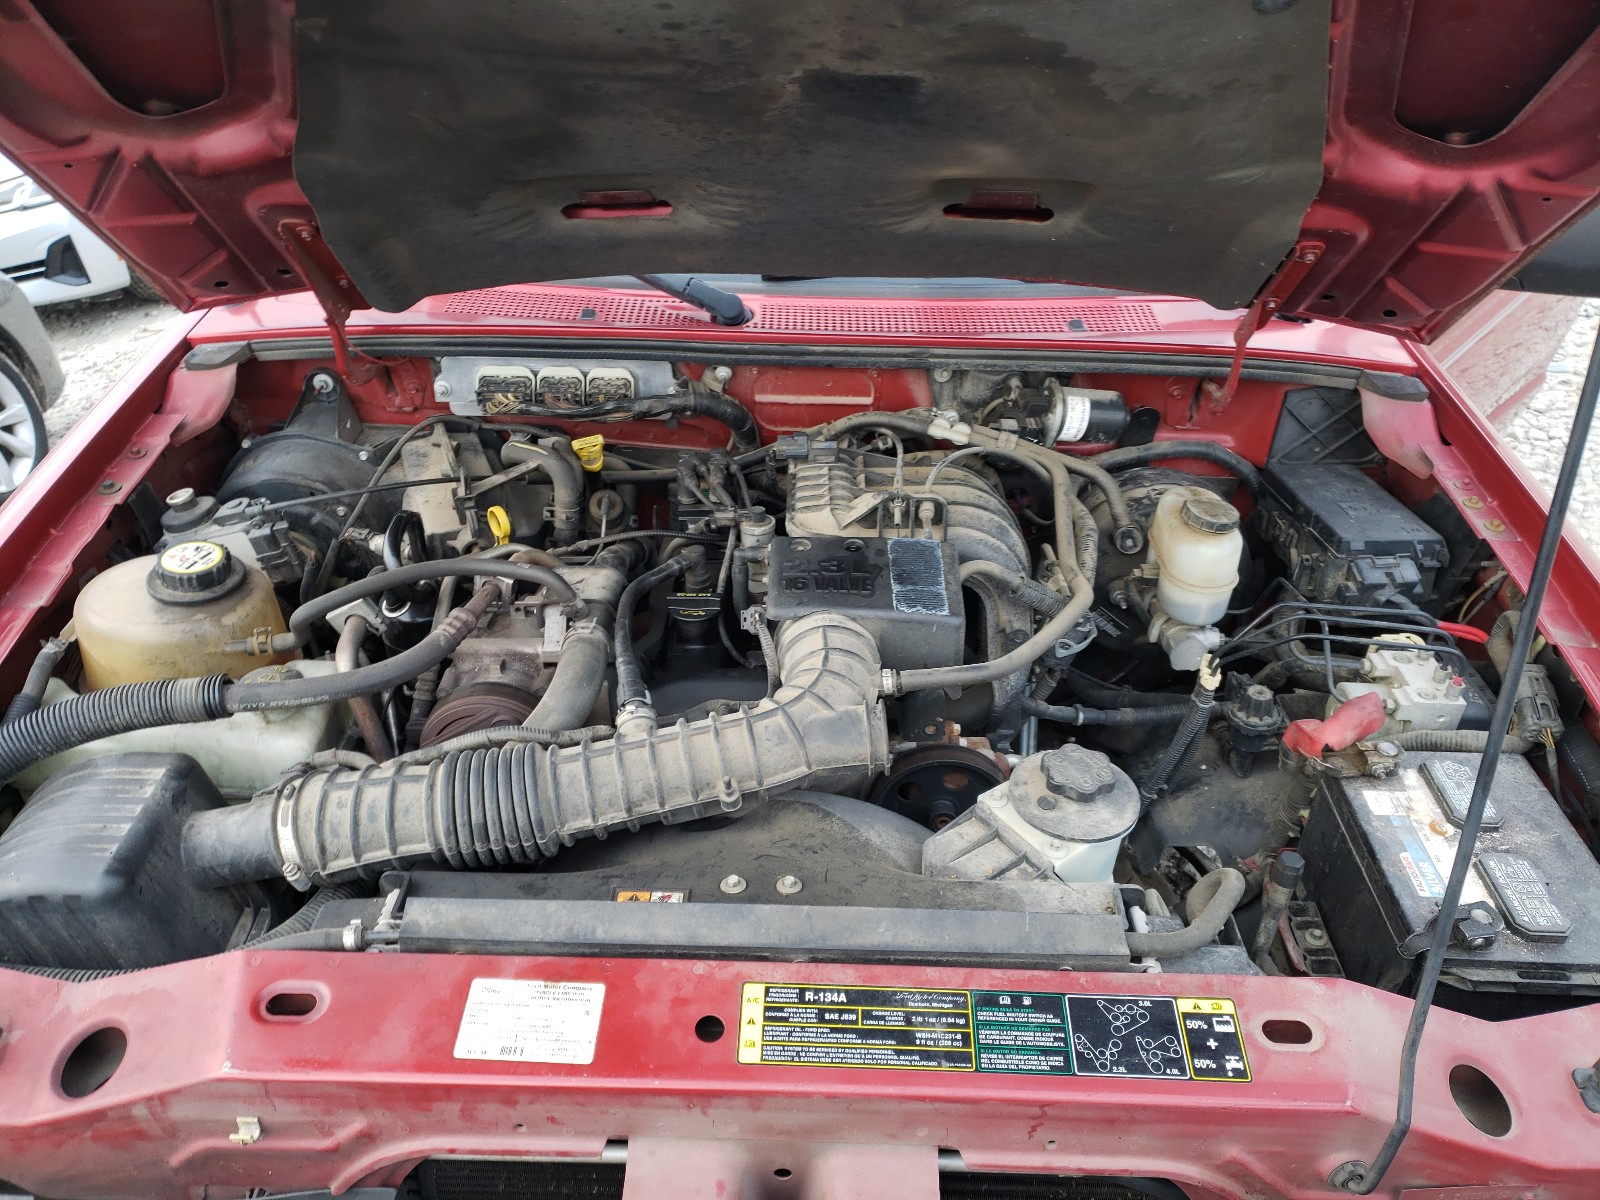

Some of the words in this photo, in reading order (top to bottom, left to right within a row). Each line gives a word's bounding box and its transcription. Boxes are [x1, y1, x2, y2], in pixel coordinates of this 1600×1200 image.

[814, 577, 872, 593] VALVE
[1418, 861, 1445, 894] SILVER
[1487, 860, 1508, 884] POISON
[1505, 889, 1527, 916] DANGER
[805, 991, 847, 1003] R-134A
[1185, 1020, 1208, 1030] 50%
[1194, 1059, 1217, 1069] 50%
